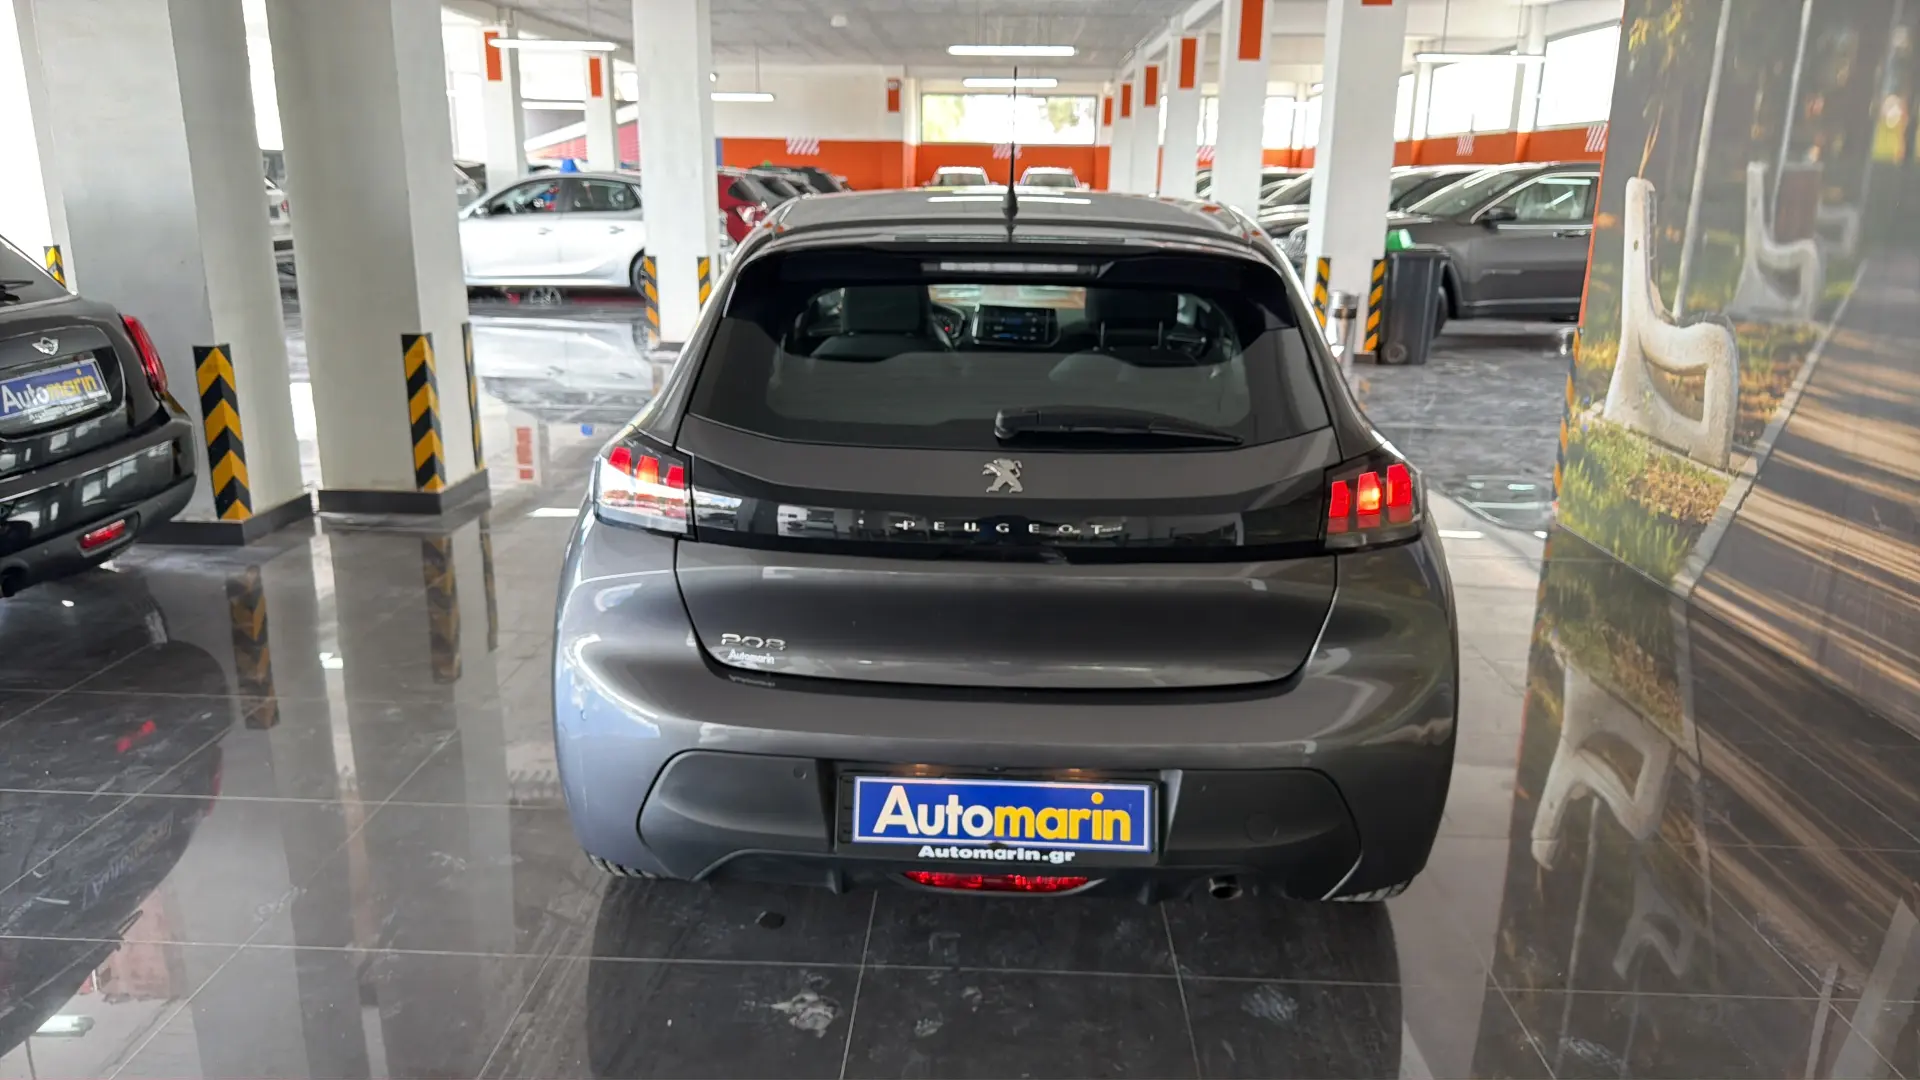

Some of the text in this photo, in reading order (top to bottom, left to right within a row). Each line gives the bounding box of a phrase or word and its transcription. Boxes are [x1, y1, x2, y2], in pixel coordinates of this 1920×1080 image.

[1, 368, 98, 413] Automarin
[902, 519, 1103, 535] PEUGEOT
[721, 633, 786, 651] 208
[727, 648, 775, 665] Automarin
[873, 785, 1131, 842] Automarin
[918, 845, 1075, 865] Automarin.gr
